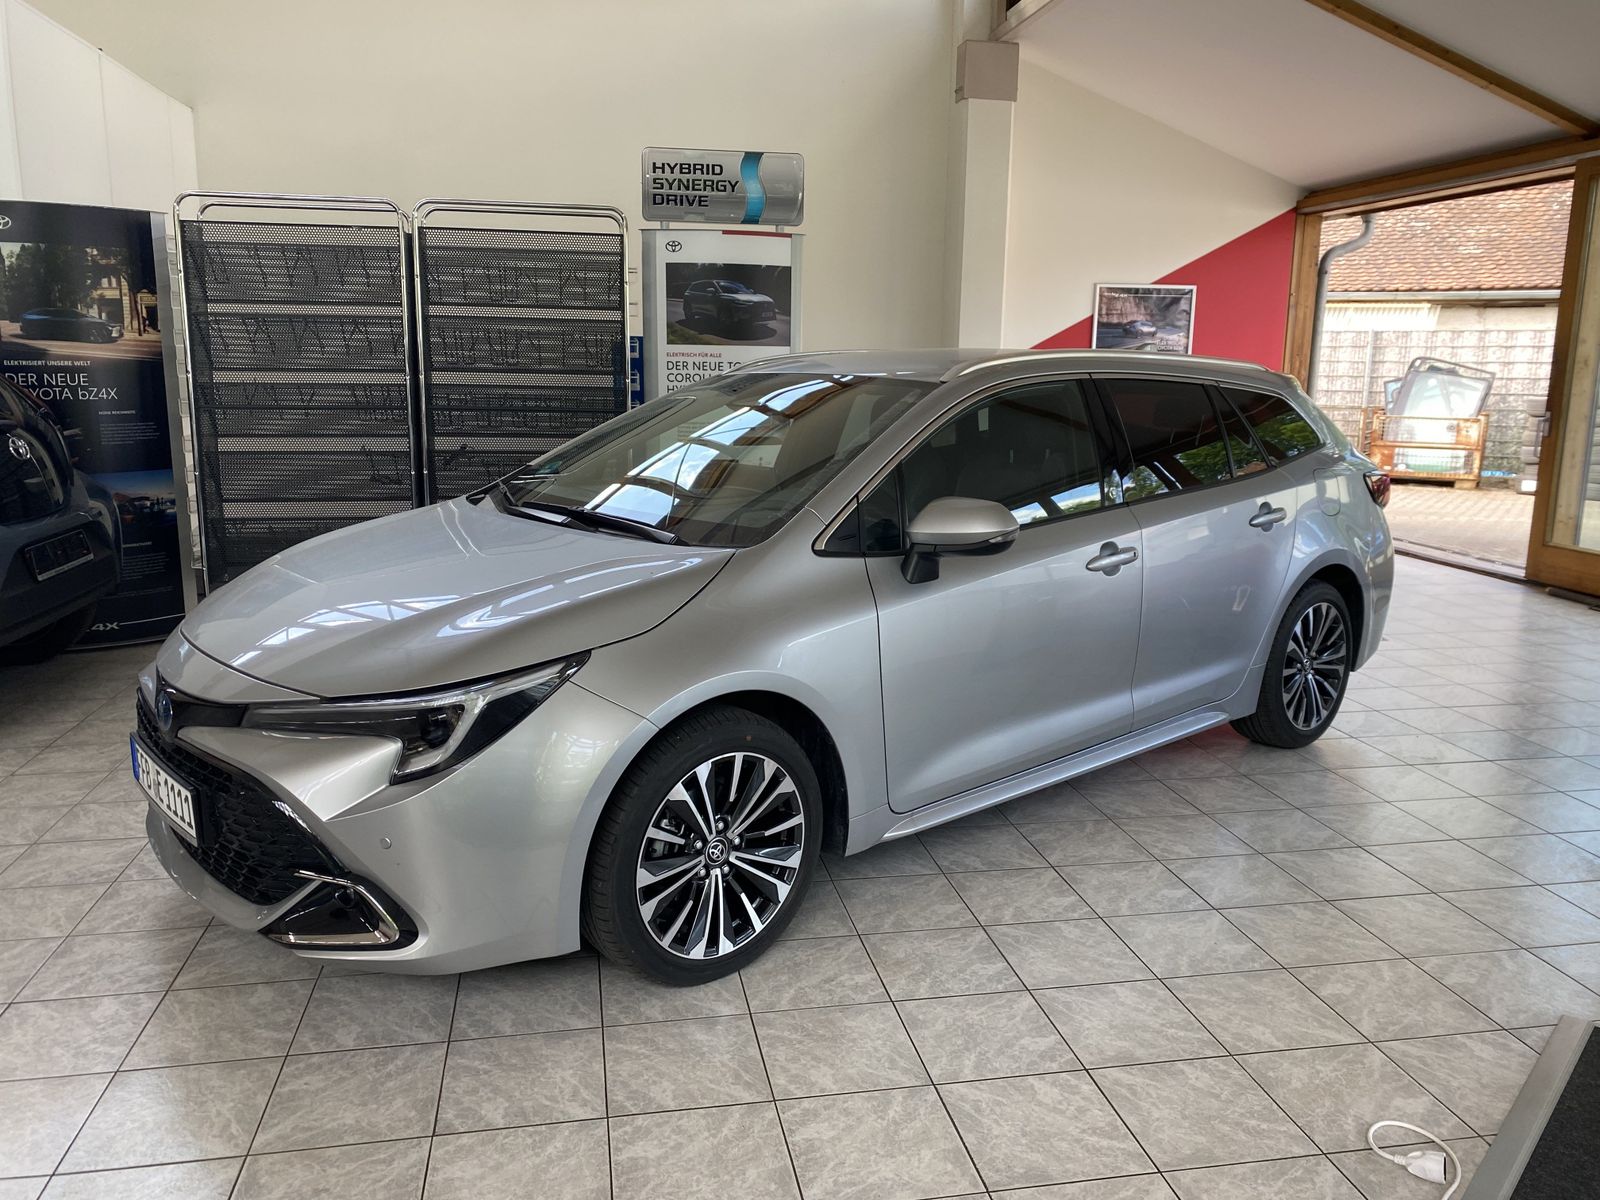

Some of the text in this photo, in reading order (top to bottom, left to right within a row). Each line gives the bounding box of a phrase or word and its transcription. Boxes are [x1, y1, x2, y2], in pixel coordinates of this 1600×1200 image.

[652, 162, 724, 176] HYBRID
[652, 178, 739, 193] SYNERGY
[652, 193, 709, 207] DRIVE
[666, 360, 689, 371] DER
[692, 361, 724, 371] NEUE
[5, 373, 89, 386] DER NEUE
[29, 387, 118, 400] YOTA bZ4X
